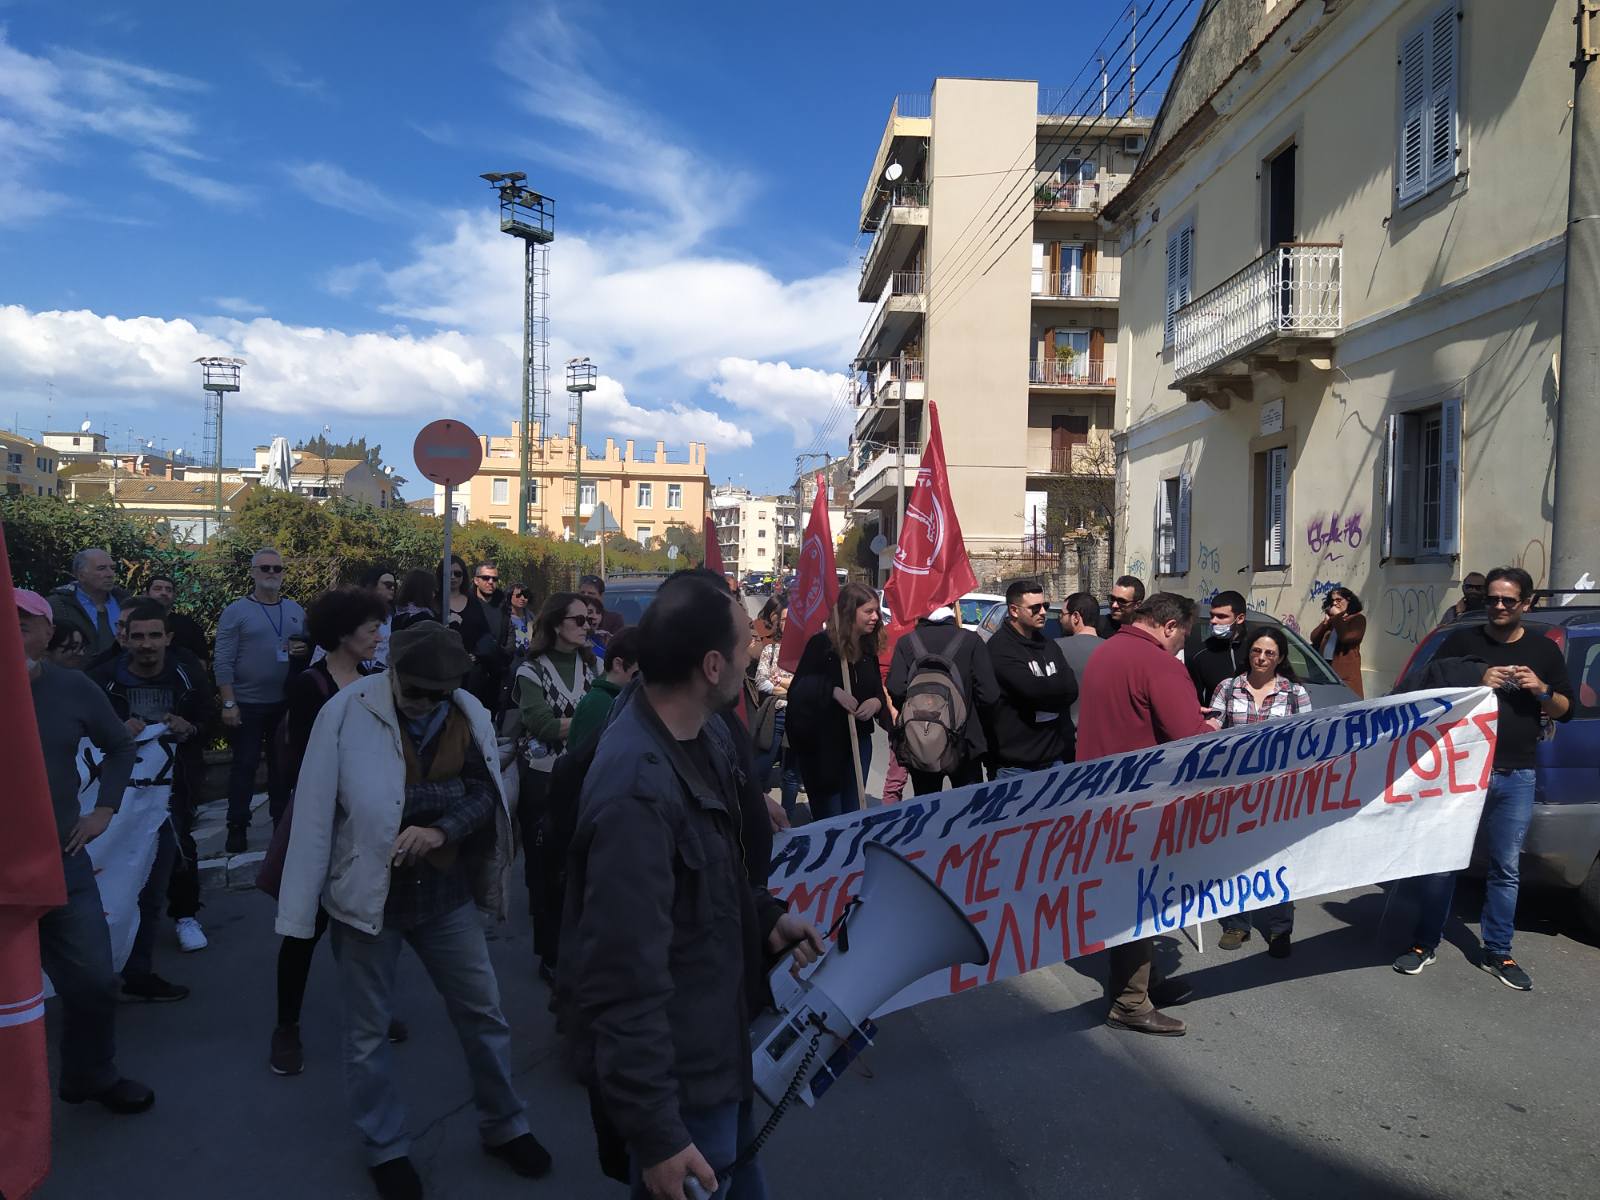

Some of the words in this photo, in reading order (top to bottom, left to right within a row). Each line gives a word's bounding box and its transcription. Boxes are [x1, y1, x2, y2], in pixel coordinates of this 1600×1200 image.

[936, 801, 1154, 905] ΜΕΤΡΑΜΕ
[1384, 711, 1499, 804] ΖΩΕΣ
[1134, 864, 1290, 937] Κέρκυρας
